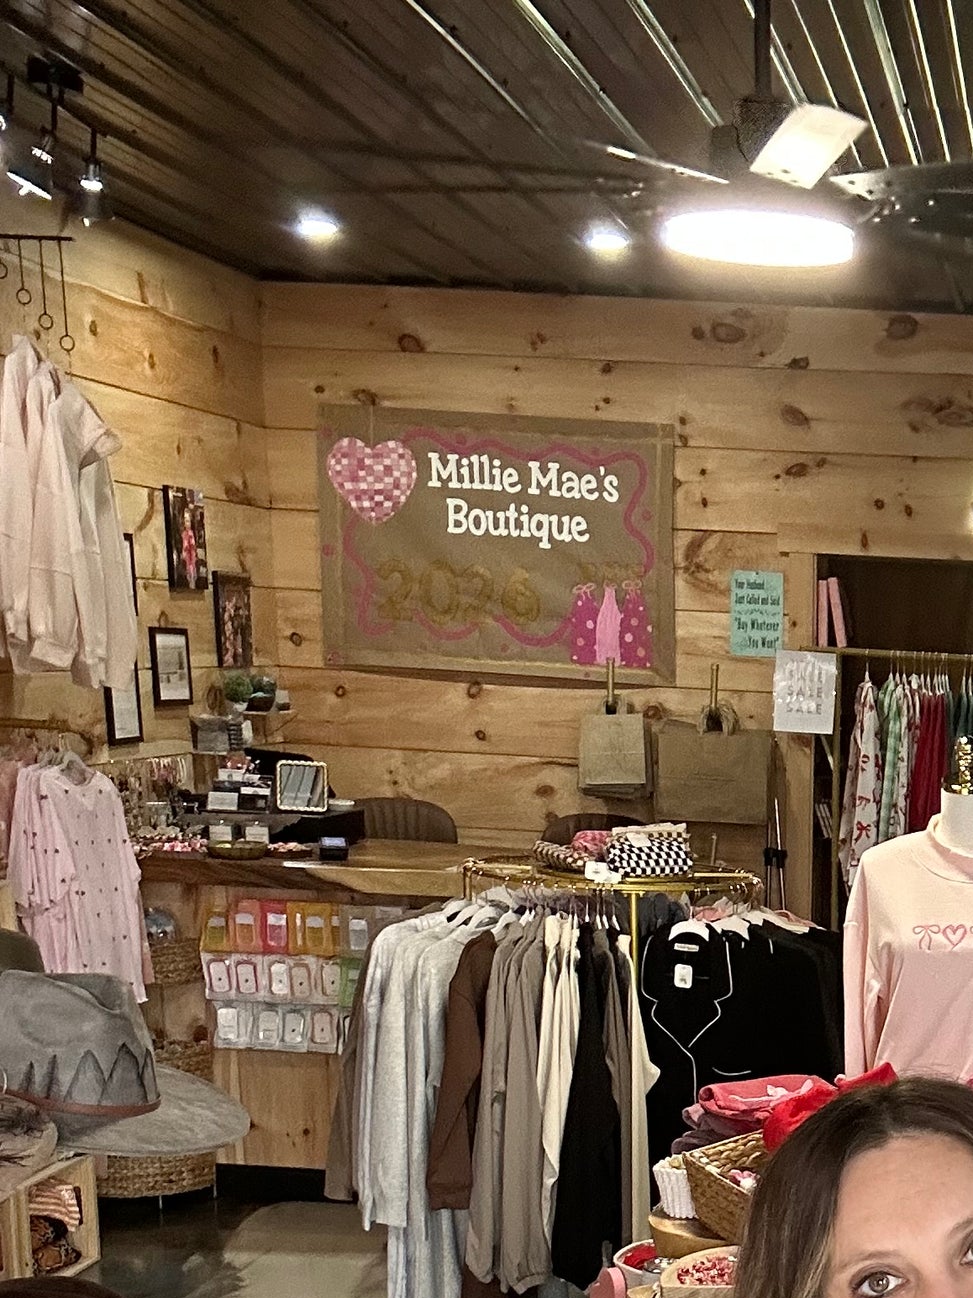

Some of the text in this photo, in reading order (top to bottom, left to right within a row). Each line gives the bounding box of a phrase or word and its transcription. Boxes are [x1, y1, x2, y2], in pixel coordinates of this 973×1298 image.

[428, 452, 619, 503] Millie Mae's
[446, 498, 590, 549] Boutique
[750, 617, 780, 631] Whatever
[787, 685, 823, 698] SALE
[786, 702, 822, 715] SALE
